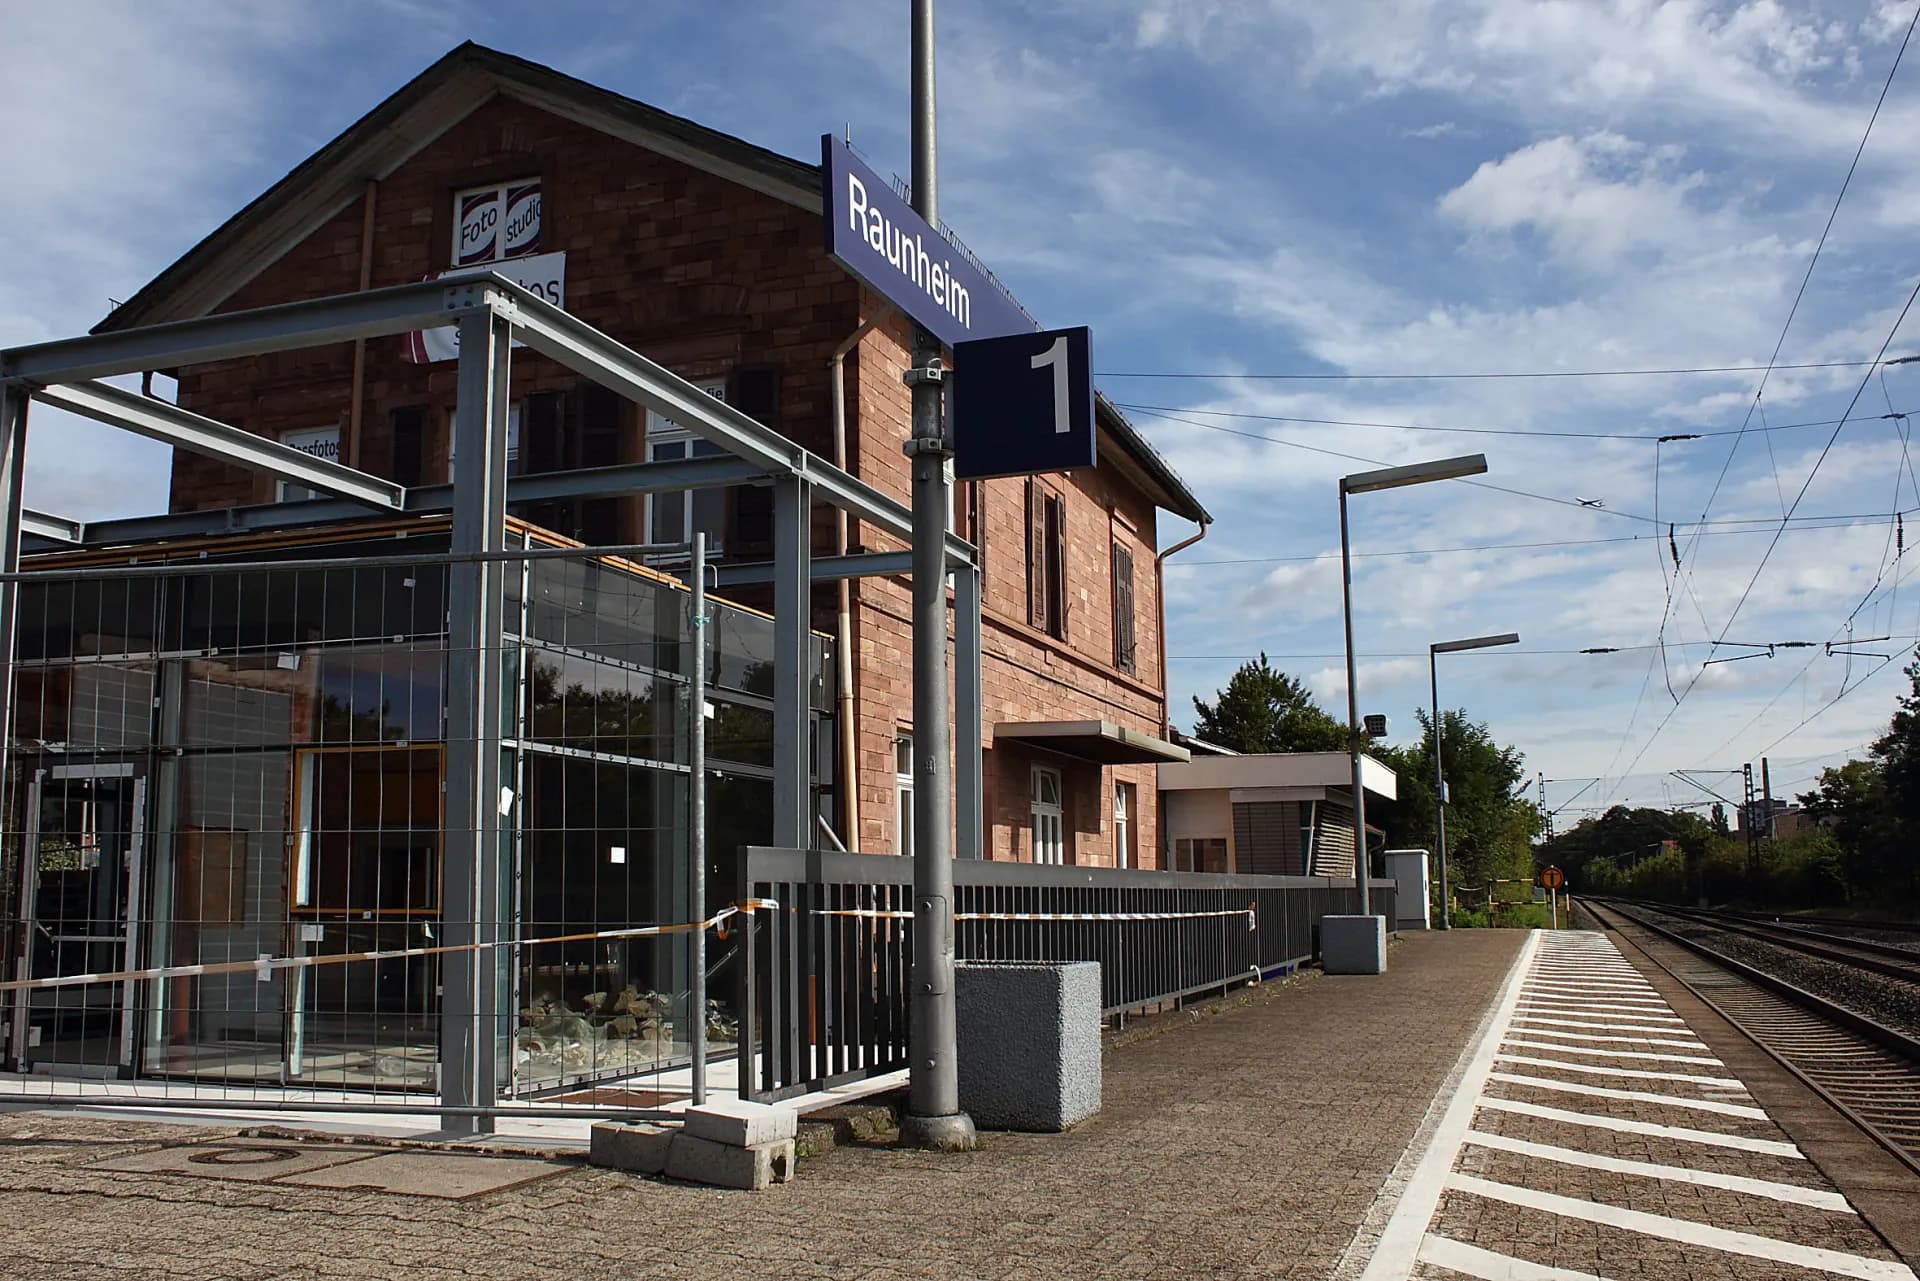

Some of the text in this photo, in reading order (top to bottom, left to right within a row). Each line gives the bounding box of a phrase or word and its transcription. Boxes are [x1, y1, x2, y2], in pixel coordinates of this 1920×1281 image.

[461, 207, 497, 250] Foto
[849, 173, 970, 329] Raunheim
[1031, 336, 1070, 434] 1
